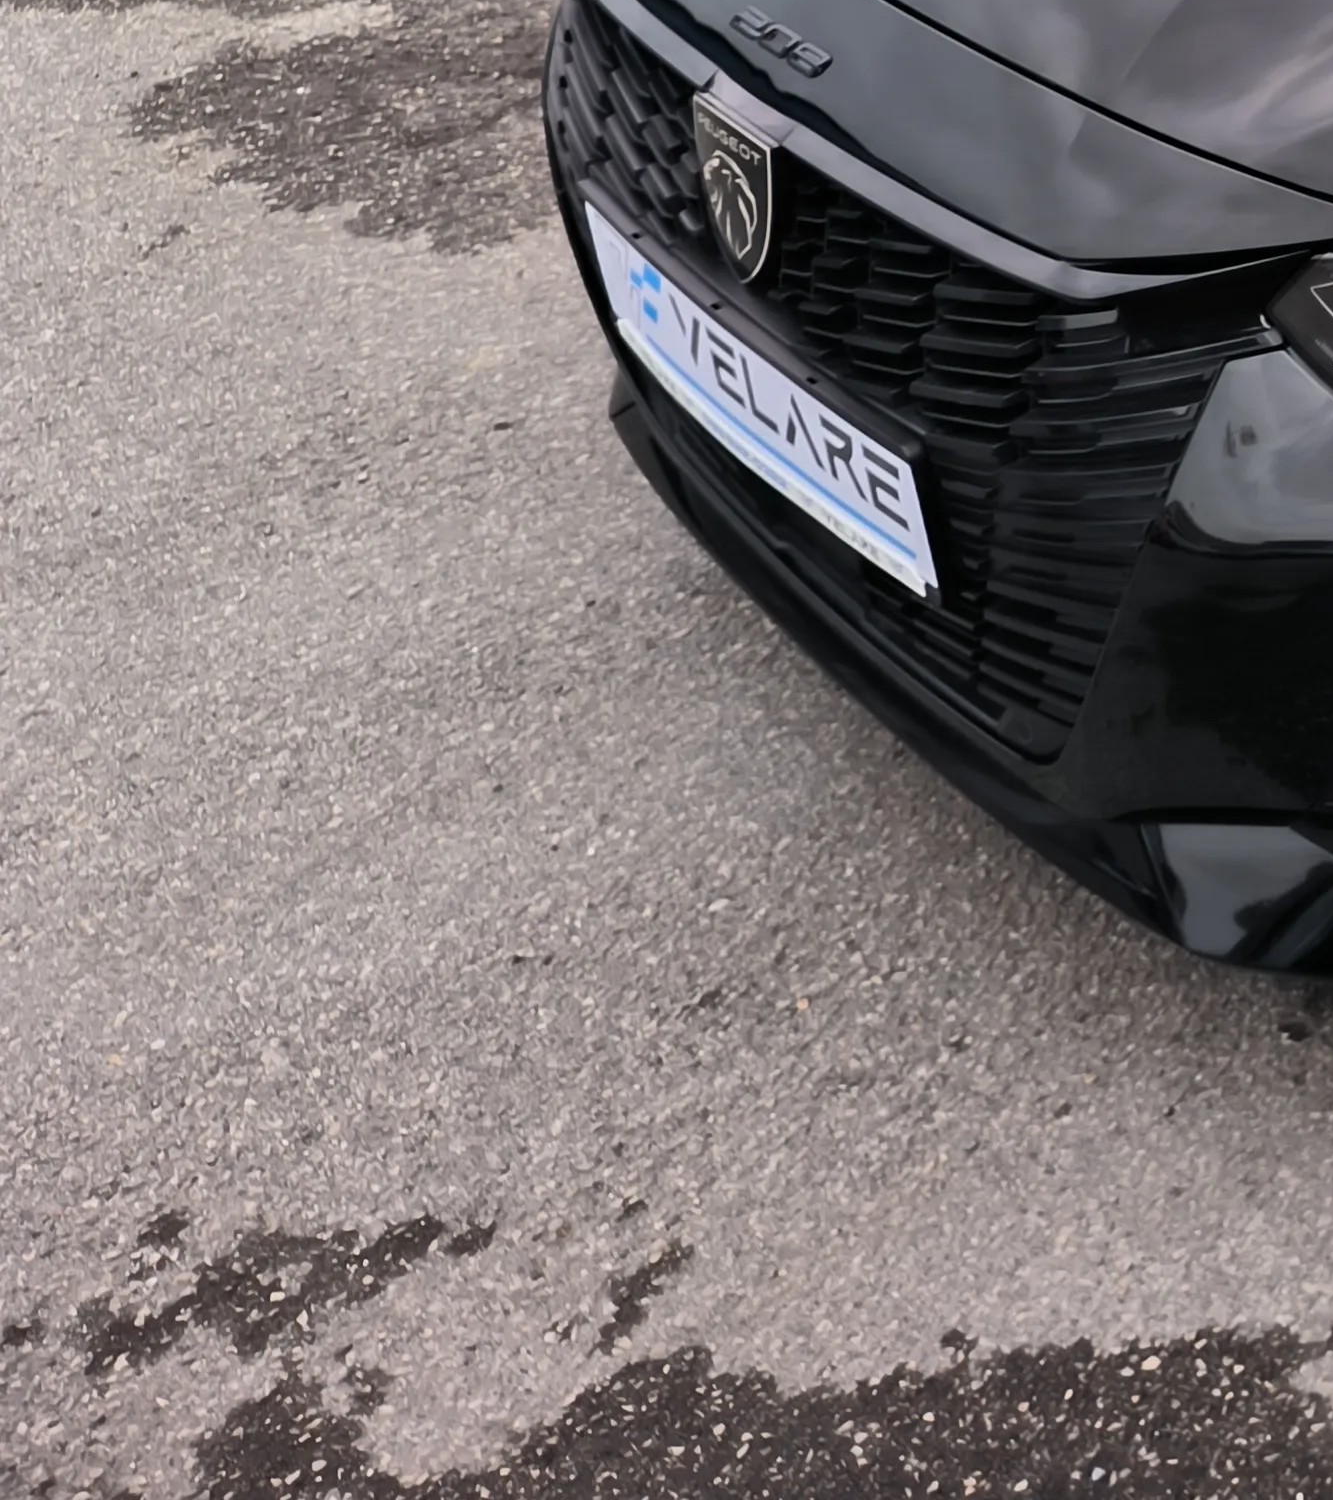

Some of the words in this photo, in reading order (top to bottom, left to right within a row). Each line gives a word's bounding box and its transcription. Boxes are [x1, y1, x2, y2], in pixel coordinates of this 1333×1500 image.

[729, 5, 834, 80] 208
[697, 112, 763, 167] PEUGEOT
[668, 292, 911, 533] VELARE
